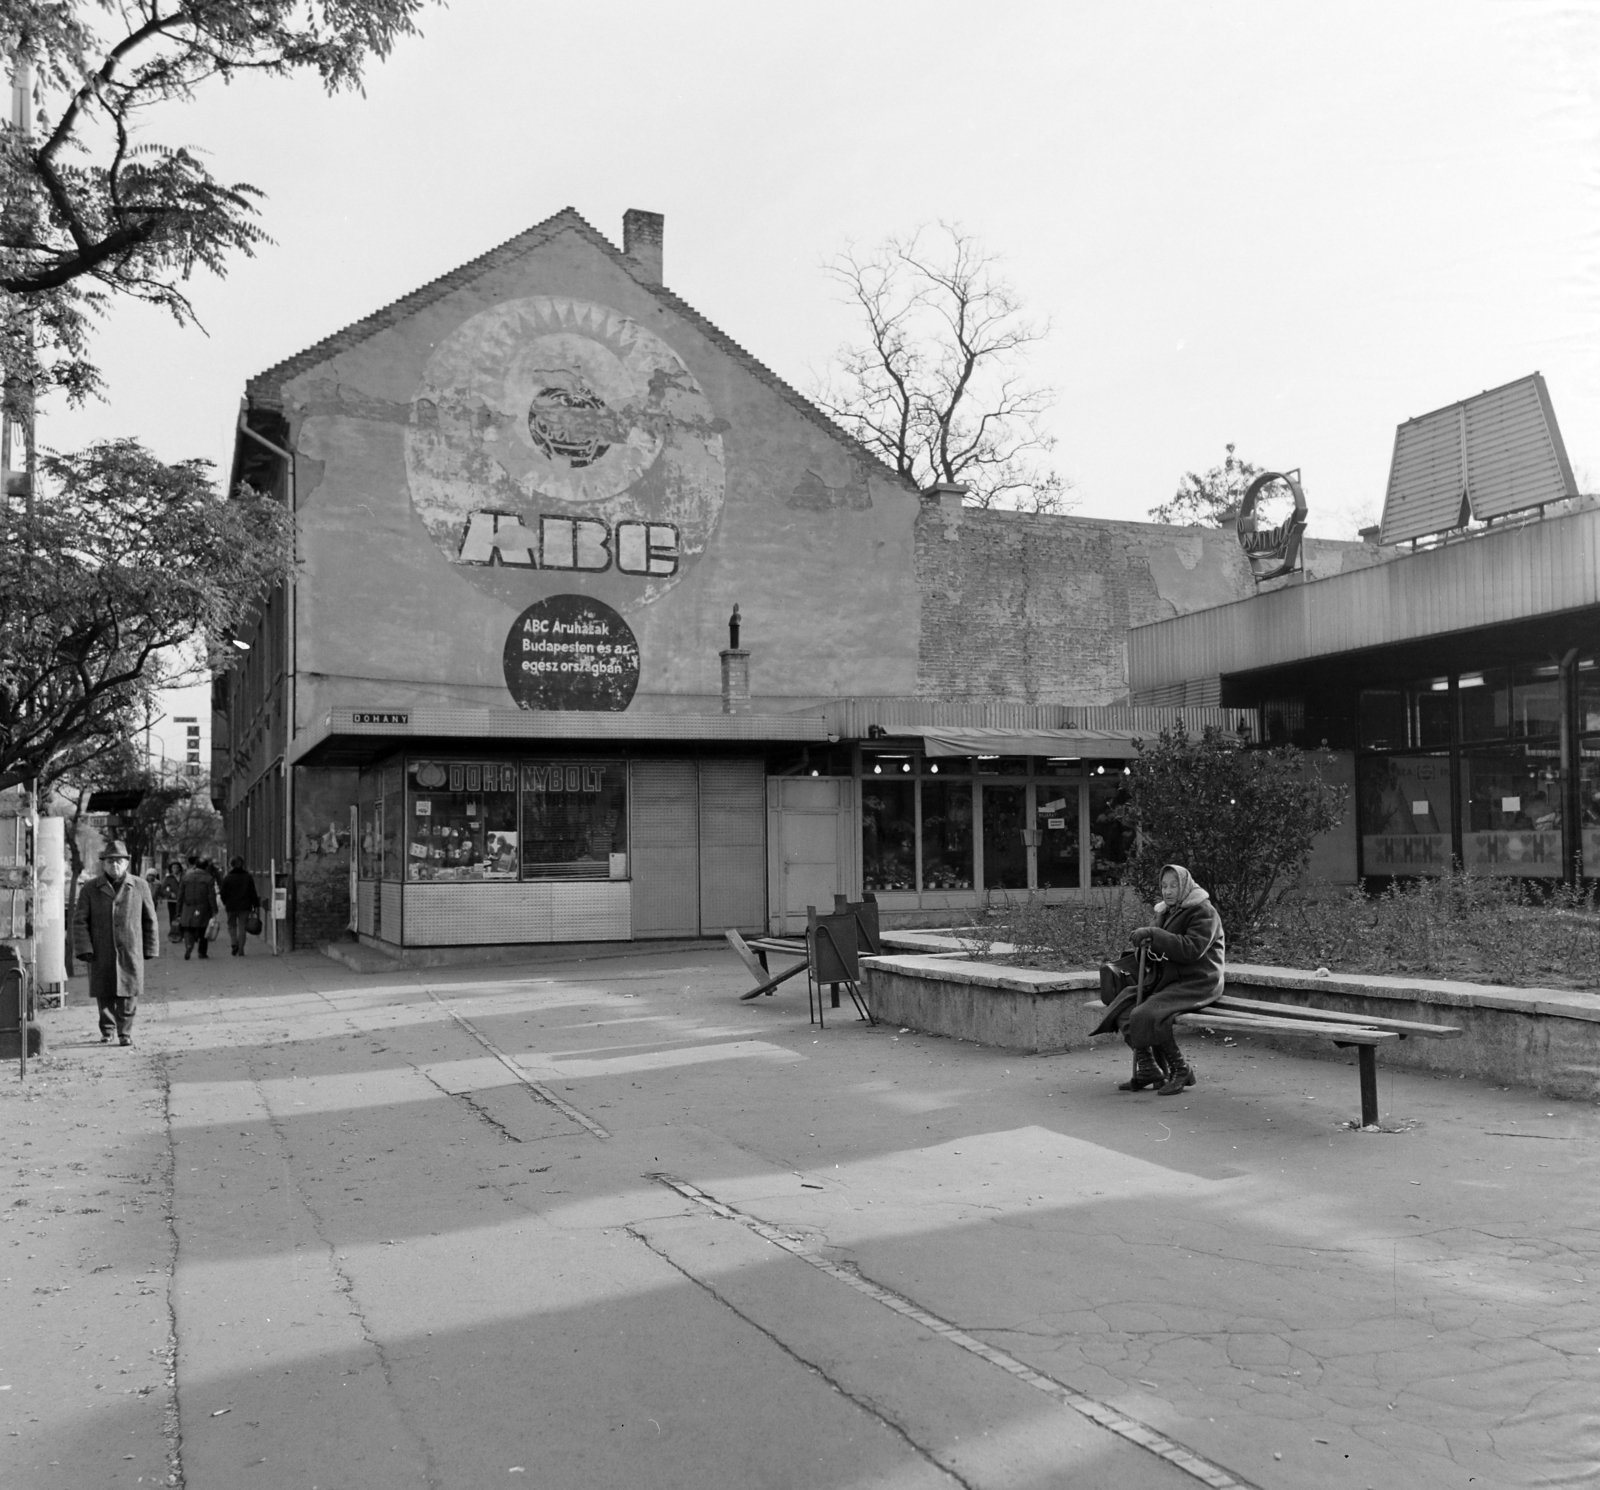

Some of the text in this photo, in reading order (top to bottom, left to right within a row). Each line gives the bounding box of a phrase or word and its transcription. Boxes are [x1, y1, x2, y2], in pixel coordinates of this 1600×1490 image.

[458, 509, 680, 578] ABC
[523, 619, 549, 633] ABC
[522, 638, 629, 656] Budapesten és az
[521, 657, 558, 676] egész
[354, 714, 407, 724] DOHANY
[187, 726, 199, 776] MOZI
